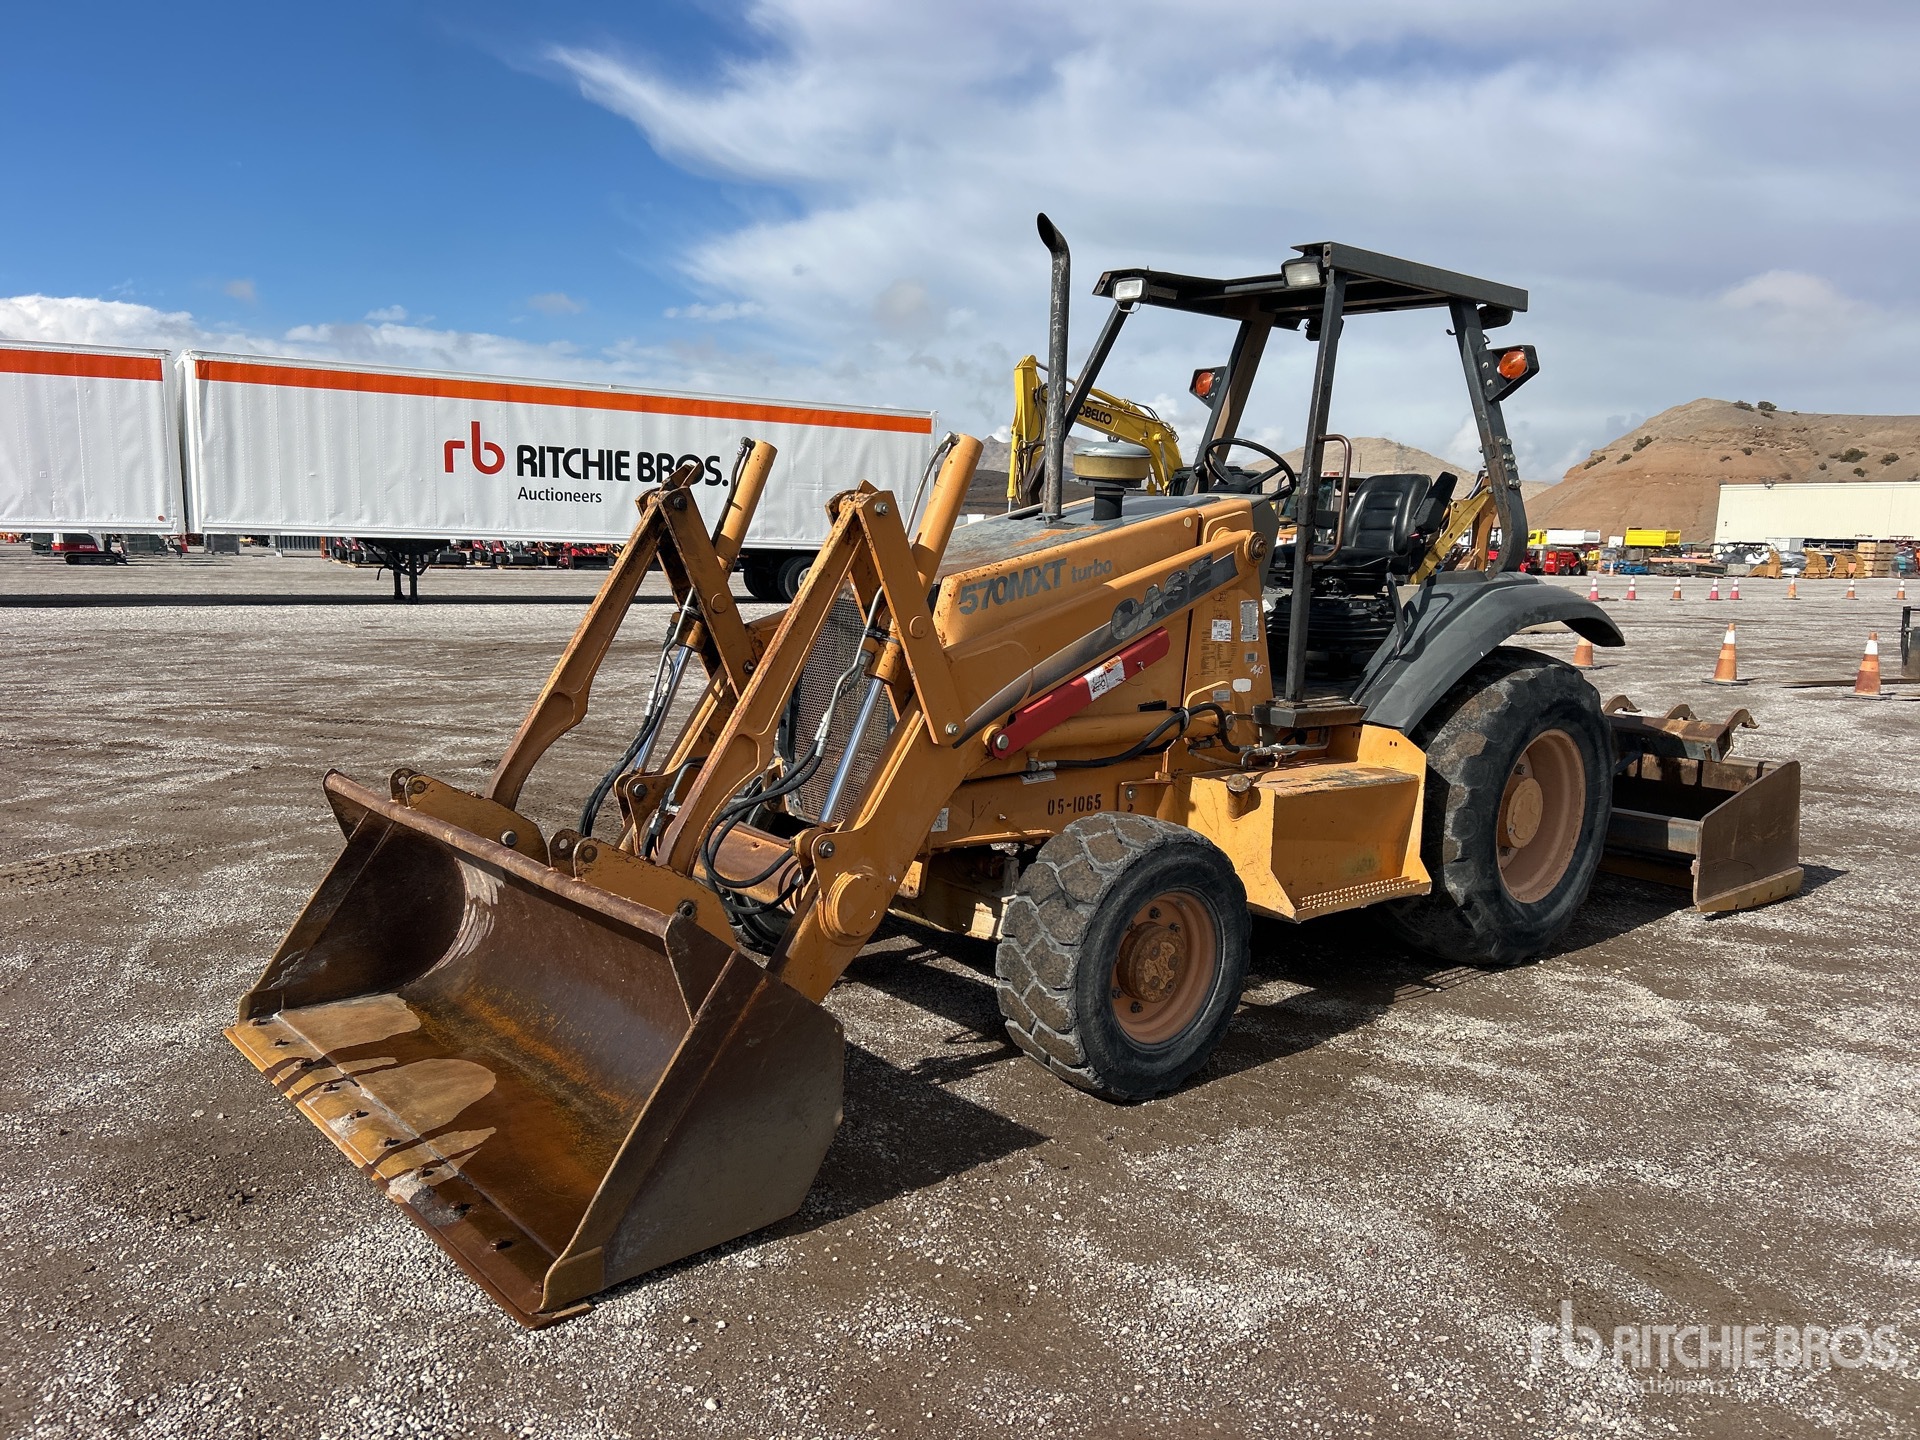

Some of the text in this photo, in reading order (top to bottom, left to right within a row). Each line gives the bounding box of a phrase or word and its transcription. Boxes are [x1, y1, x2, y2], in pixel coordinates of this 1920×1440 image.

[1078, 404, 1113, 425] OBELCO
[444, 421, 505, 475] rb
[516, 445, 631, 482] RITCHIE
[517, 486, 602, 504] Auctioneers
[958, 557, 1113, 615] 570MXT turbo
